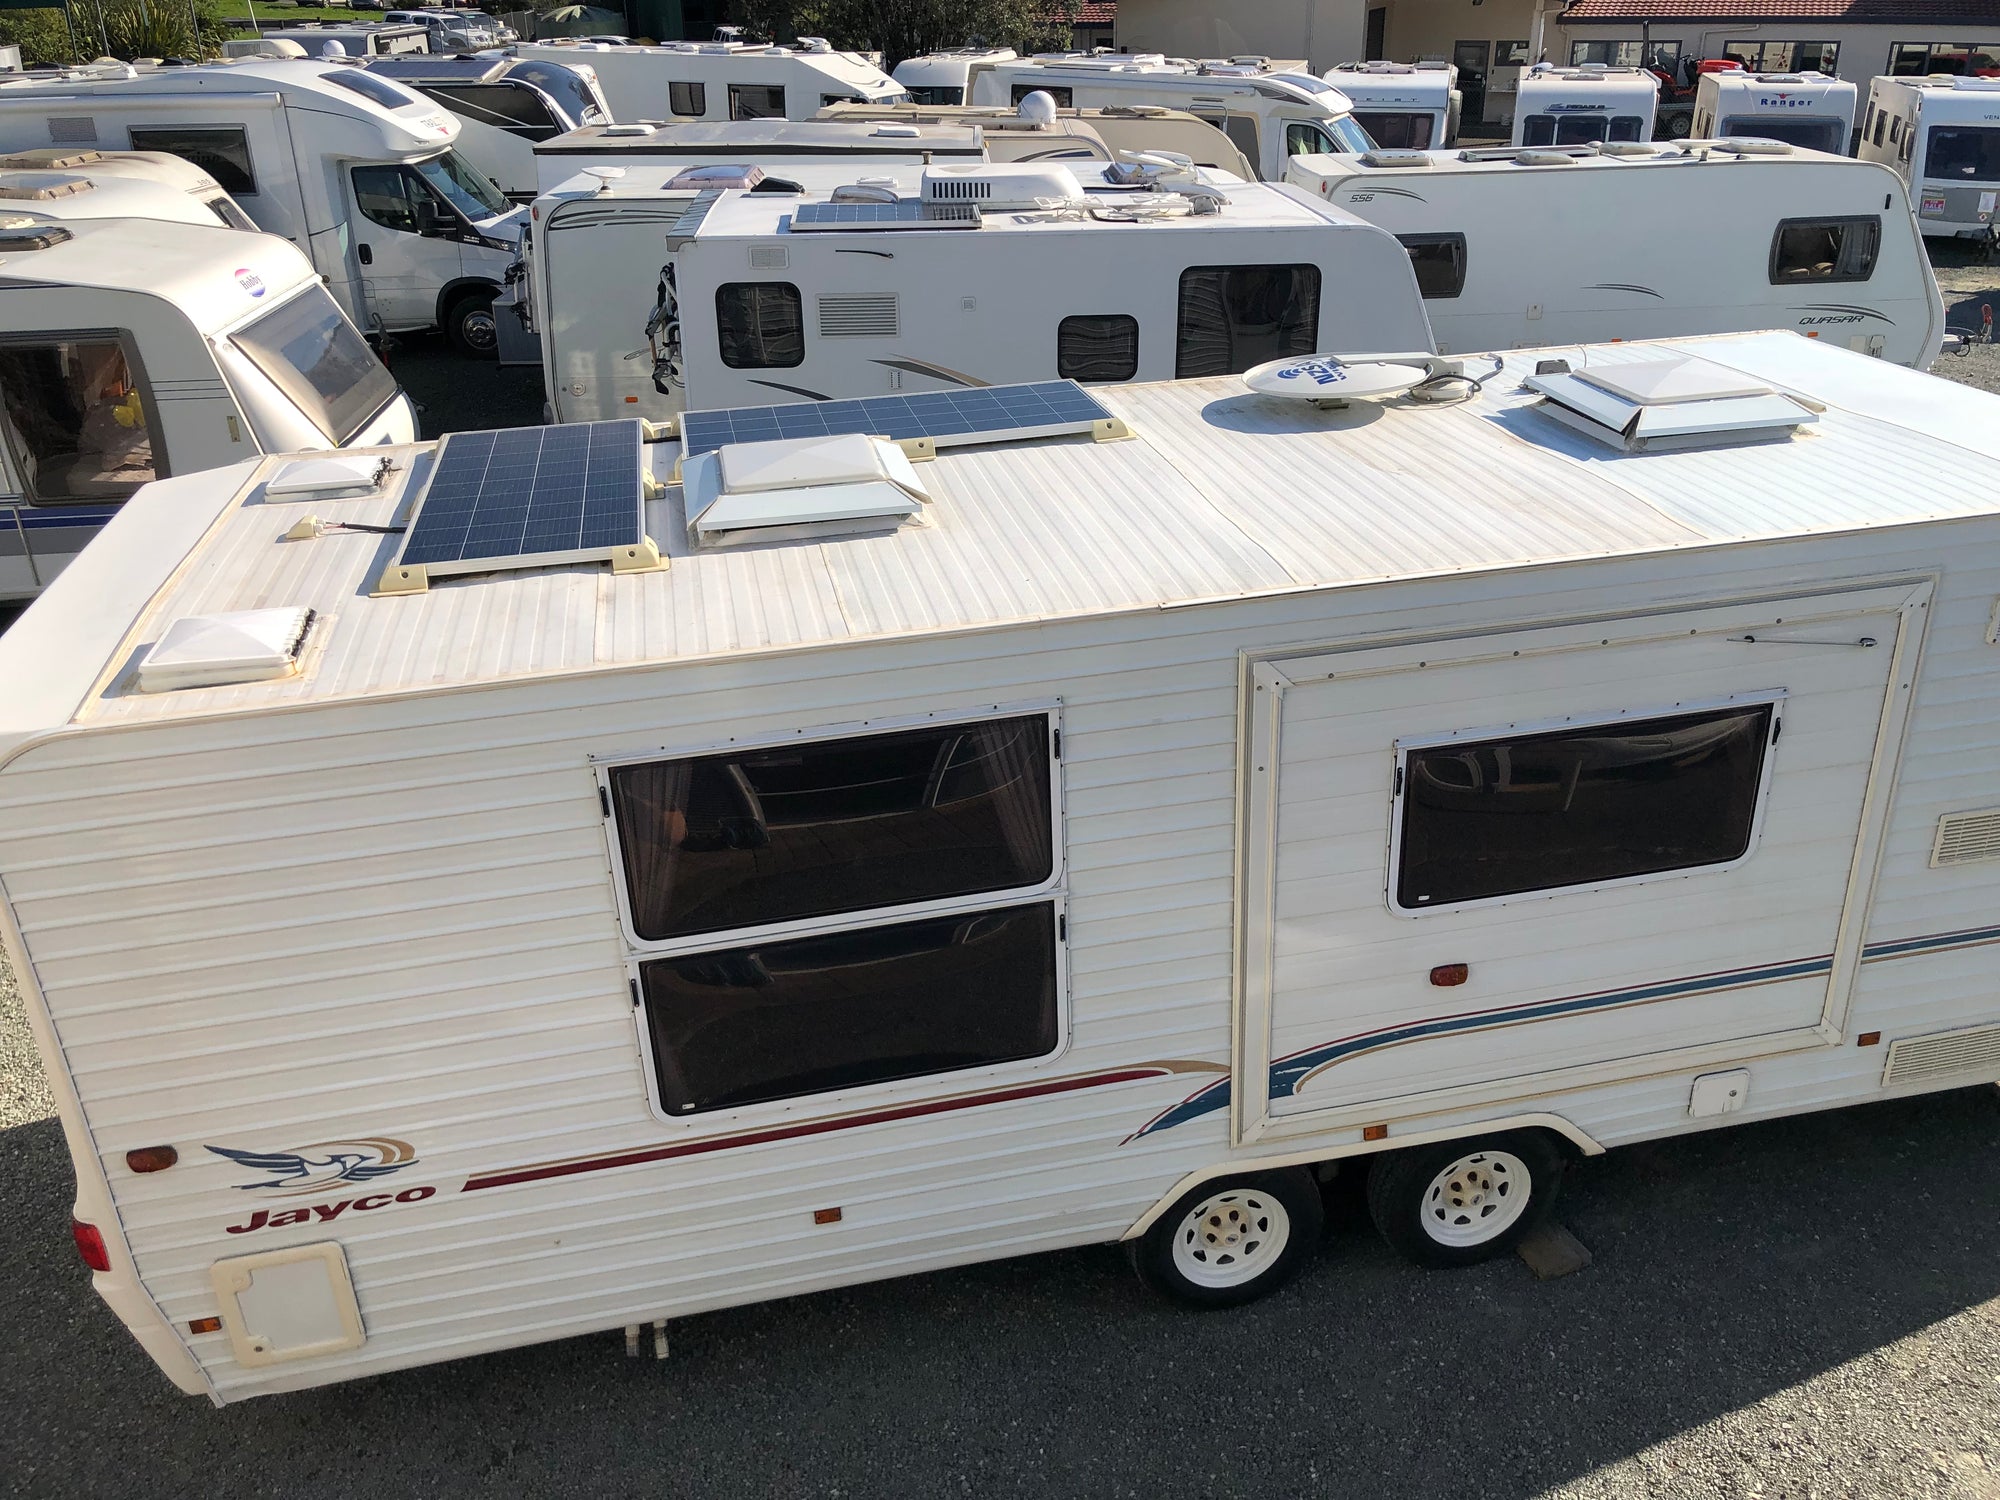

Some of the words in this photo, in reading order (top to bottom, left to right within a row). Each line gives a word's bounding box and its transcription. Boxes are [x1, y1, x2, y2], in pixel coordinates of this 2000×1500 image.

[1760, 98, 1812, 108] Ranger
[1349, 193, 1375, 203] 556
[240, 274, 263, 290] Hobby
[1799, 315, 1865, 325] QUASAR
[226, 1186, 436, 1234] Jayco
